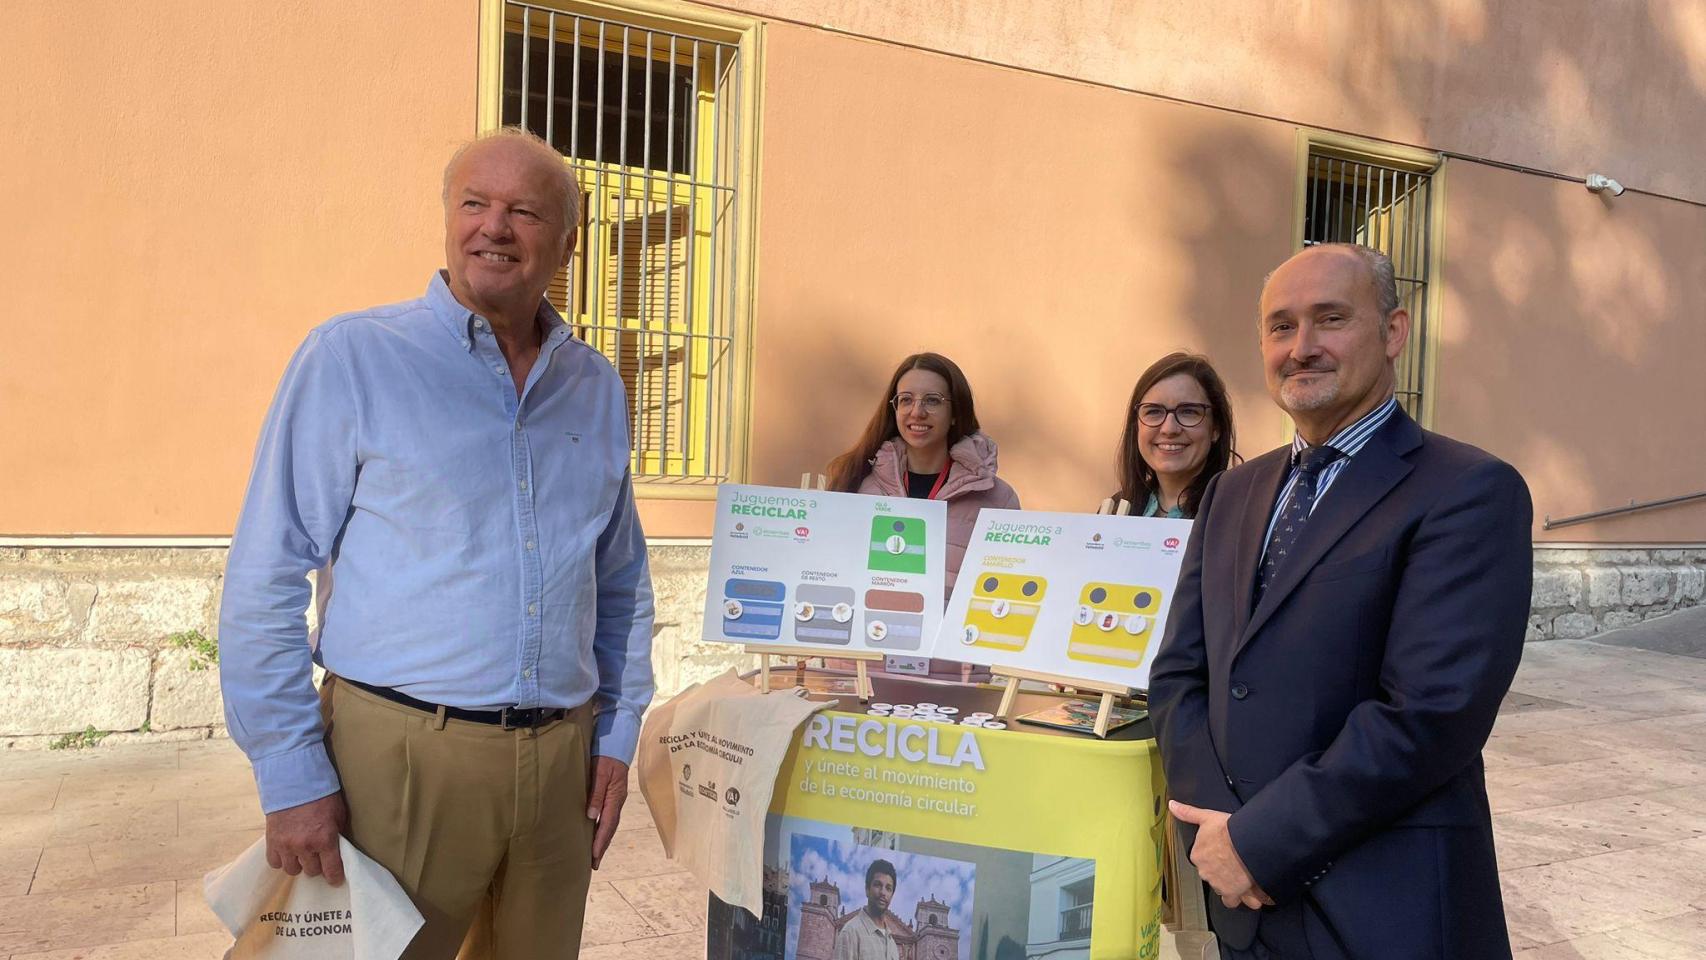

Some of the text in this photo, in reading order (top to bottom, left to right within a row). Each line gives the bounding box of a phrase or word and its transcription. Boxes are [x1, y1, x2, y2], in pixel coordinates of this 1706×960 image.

[731, 491, 817, 508] Juguemos a
[731, 504, 807, 520] RECICLAR
[988, 520, 1063, 535] Juguemos a
[984, 532, 1052, 546] RECICLAR
[731, 565, 768, 573] CONTENEDOR
[801, 570, 838, 578] CONTENEDOR
[871, 576, 908, 584] CONTENEDOR
[659, 734, 689, 745] RECICLA
[803, 714, 985, 771] RECICLA
[670, 744, 683, 753] DE
[804, 757, 976, 793] y únete al movimiento
[800, 777, 979, 817] de la economía circular.
[260, 911, 293, 923] RECICLA
[295, 914, 301, 923] Y
[304, 910, 342, 923] ÚNETE
[275, 926, 284, 936] DE
[286, 927, 297, 937] LA
